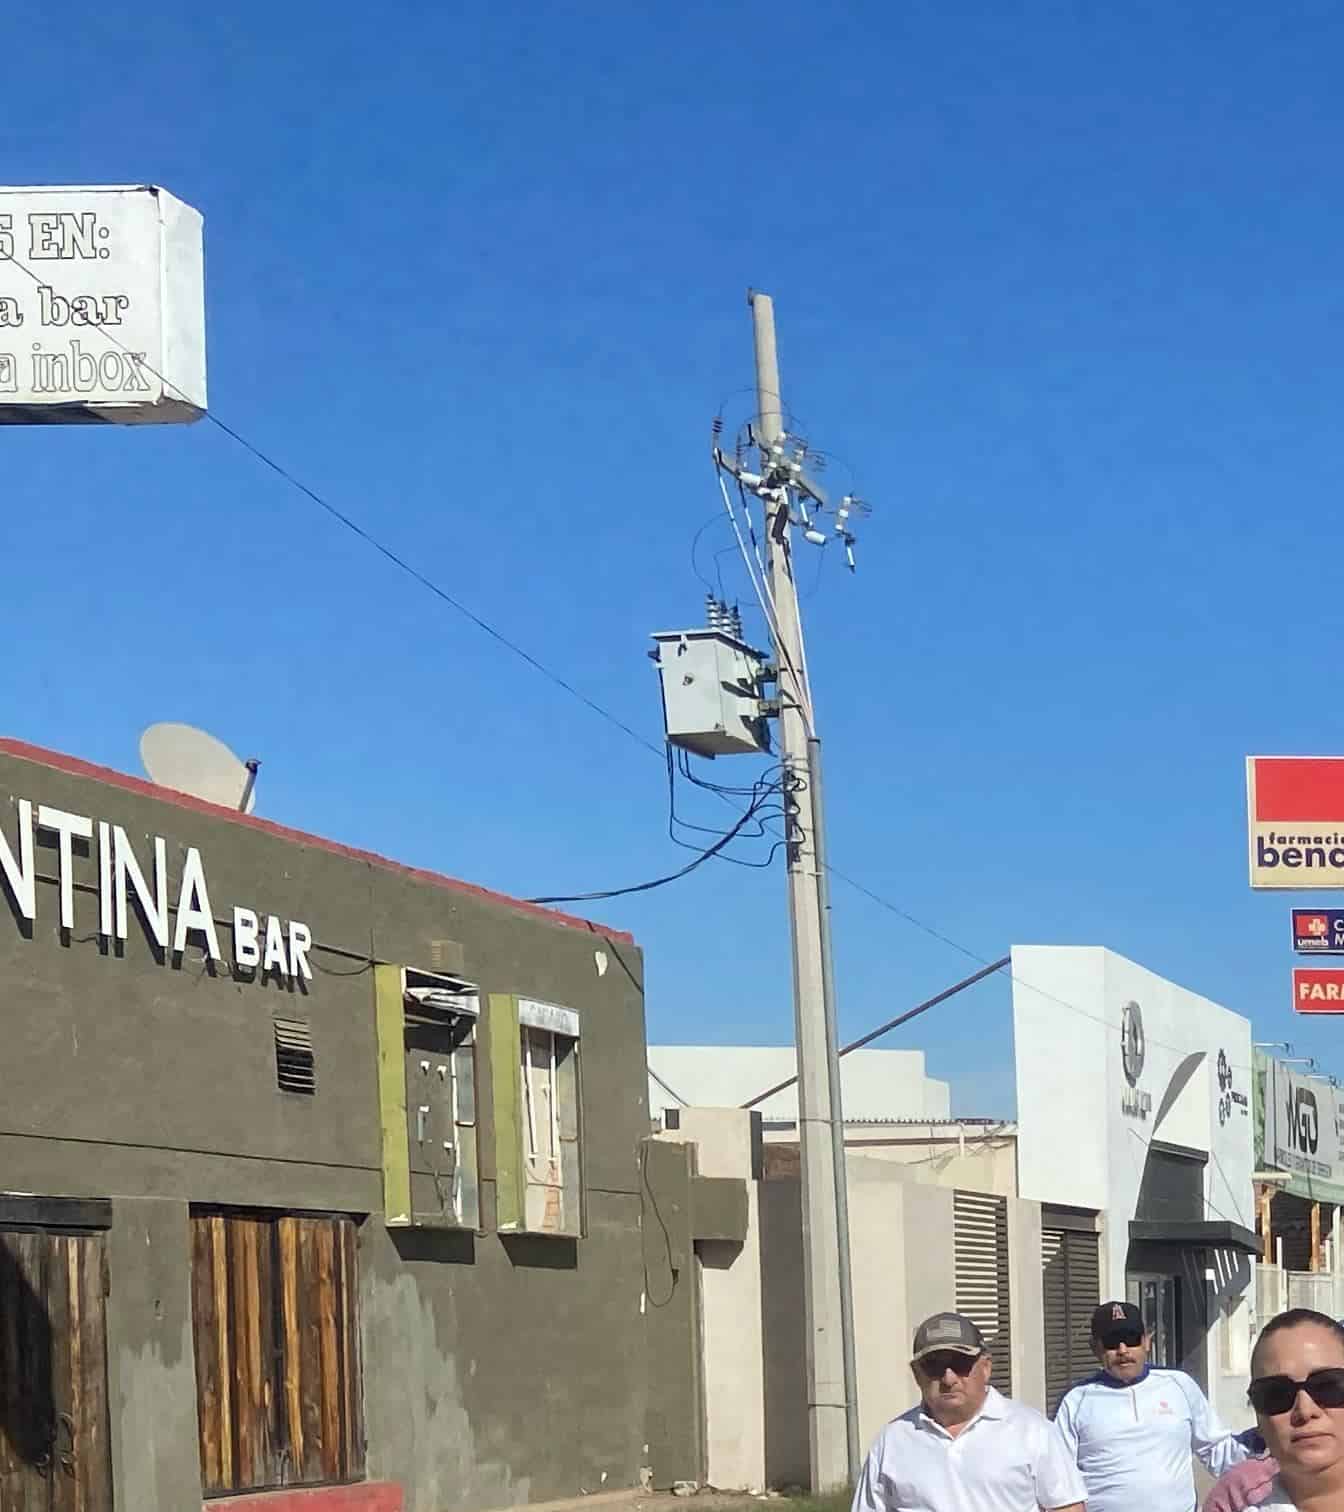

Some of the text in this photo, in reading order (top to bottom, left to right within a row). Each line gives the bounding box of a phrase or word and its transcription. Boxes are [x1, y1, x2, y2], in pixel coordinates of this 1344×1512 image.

[28, 213, 110, 260] EN:
[37, 286, 129, 326] bar
[32, 340, 151, 392] inbox
[0, 799, 312, 980] NTINA BAR
